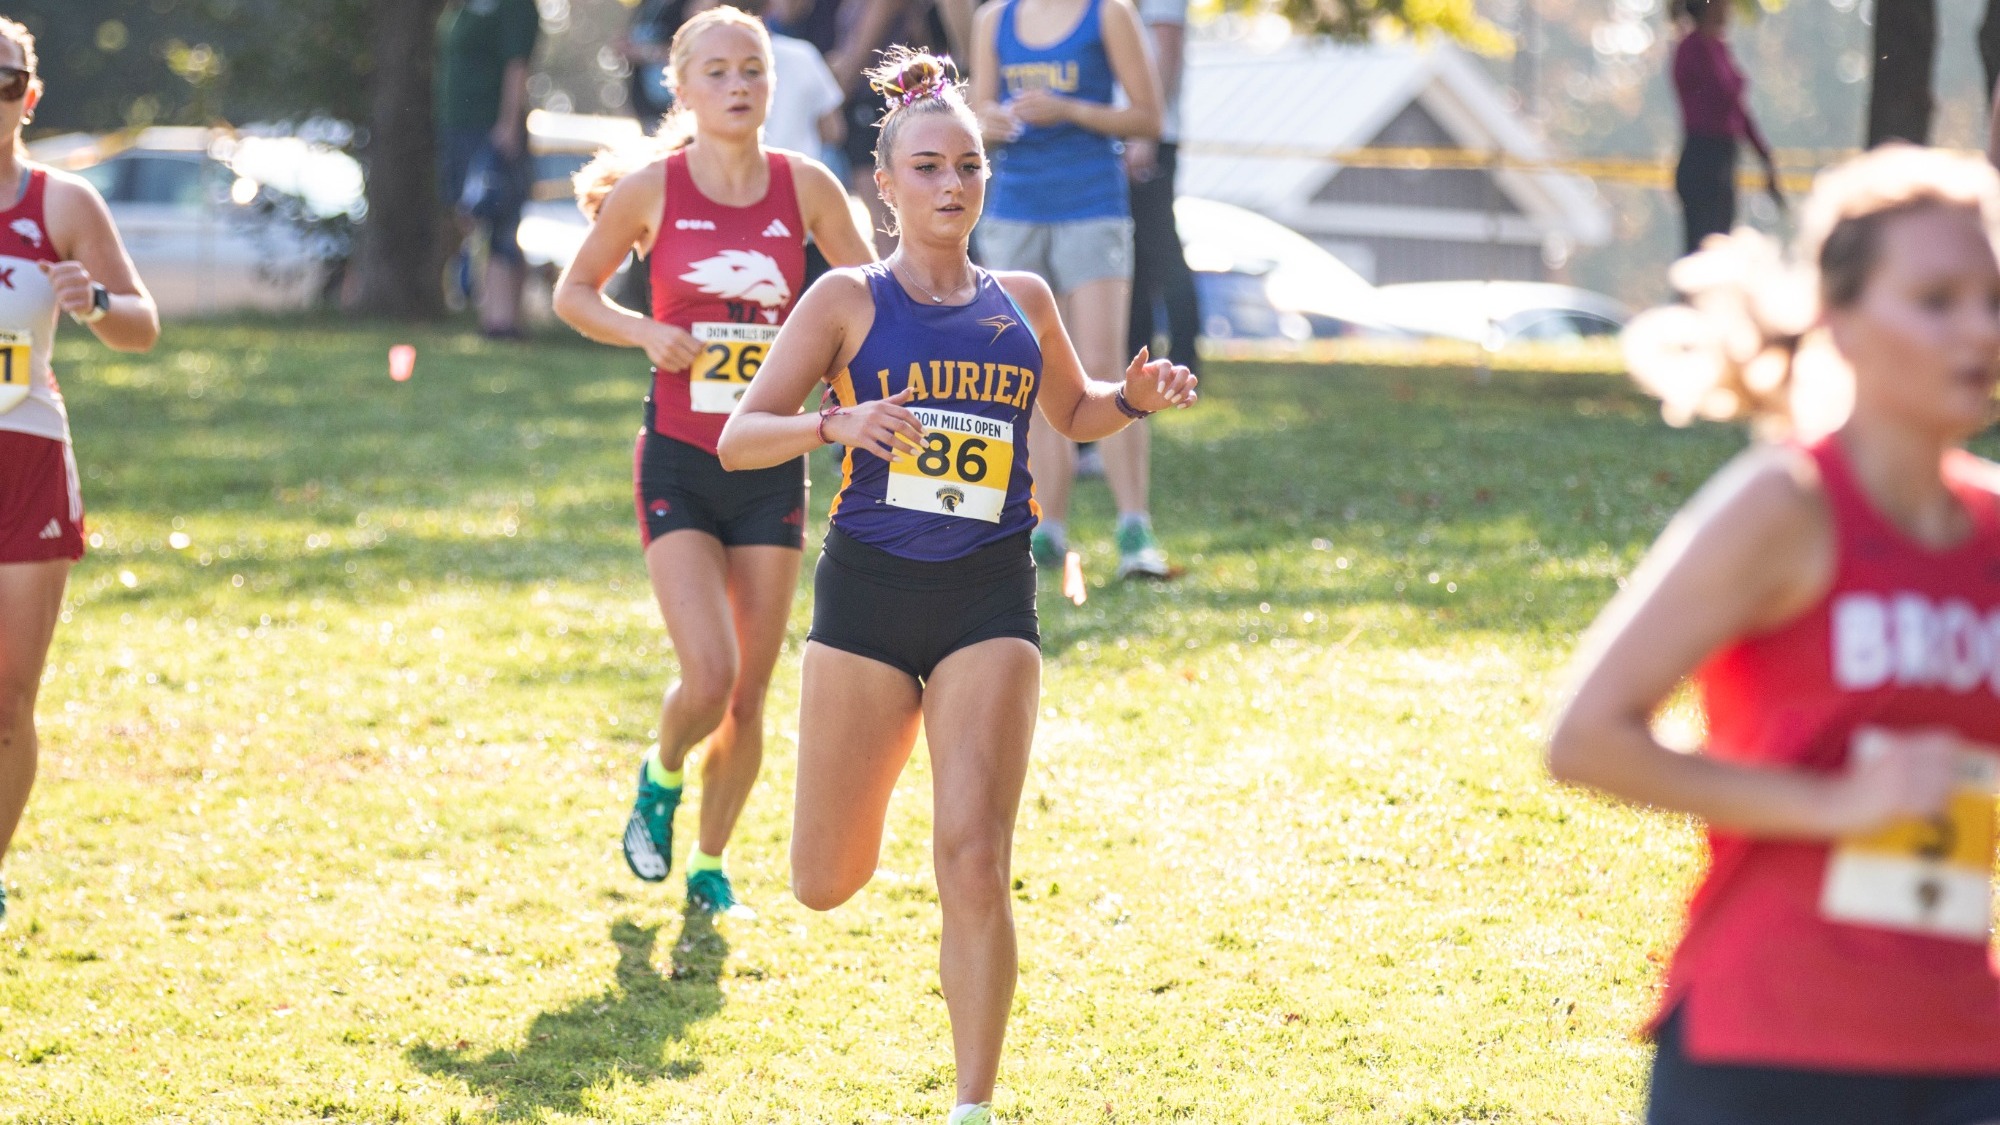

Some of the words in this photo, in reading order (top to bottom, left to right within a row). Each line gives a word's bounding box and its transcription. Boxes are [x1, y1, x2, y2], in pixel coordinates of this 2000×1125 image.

[705, 344, 762, 382] 26
[878, 360, 1035, 411] LAURIER
[914, 412, 938, 427] DON
[942, 415, 972, 433] MILLS
[975, 421, 1001, 438] OPEN
[917, 432, 988, 483] 86
[1831, 592, 2000, 694] BRO
